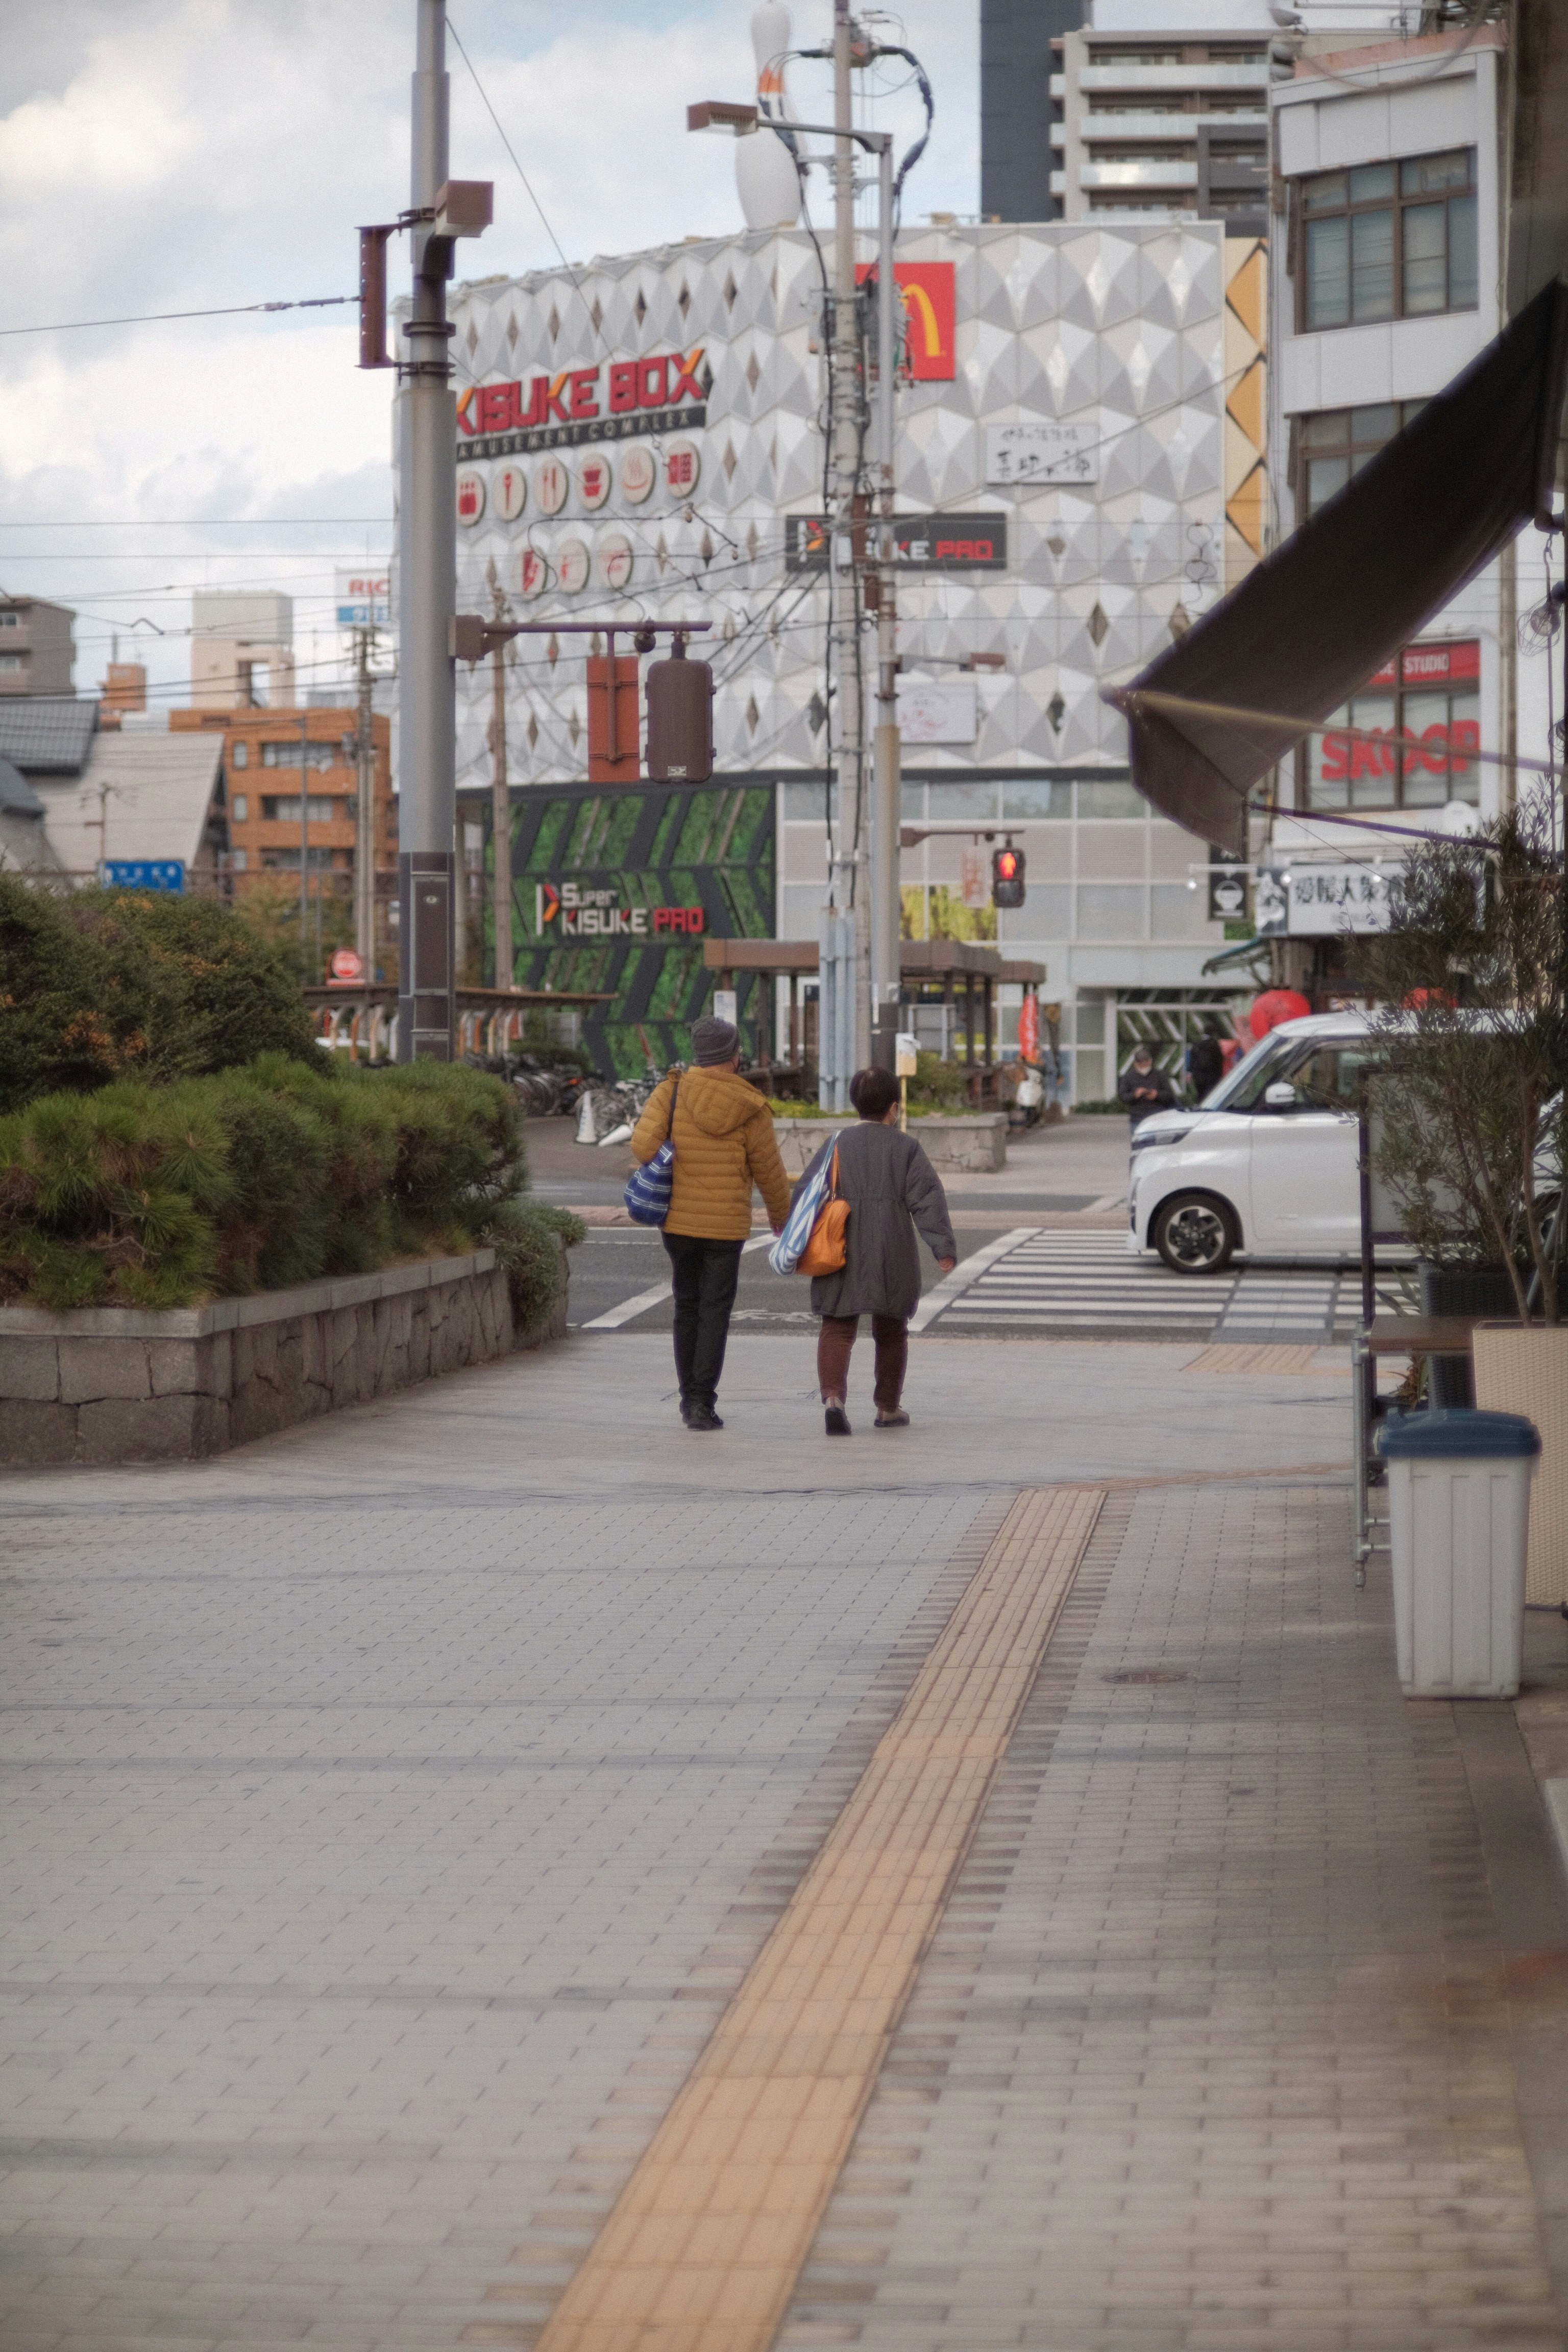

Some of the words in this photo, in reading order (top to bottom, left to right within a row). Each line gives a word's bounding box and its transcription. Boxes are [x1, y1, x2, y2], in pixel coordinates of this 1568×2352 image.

[609, 349, 704, 411] BOX
[459, 426, 580, 457] AMUSEMENT
[587, 413, 689, 439] COMPLEX
[562, 908, 648, 935] KISUKE
